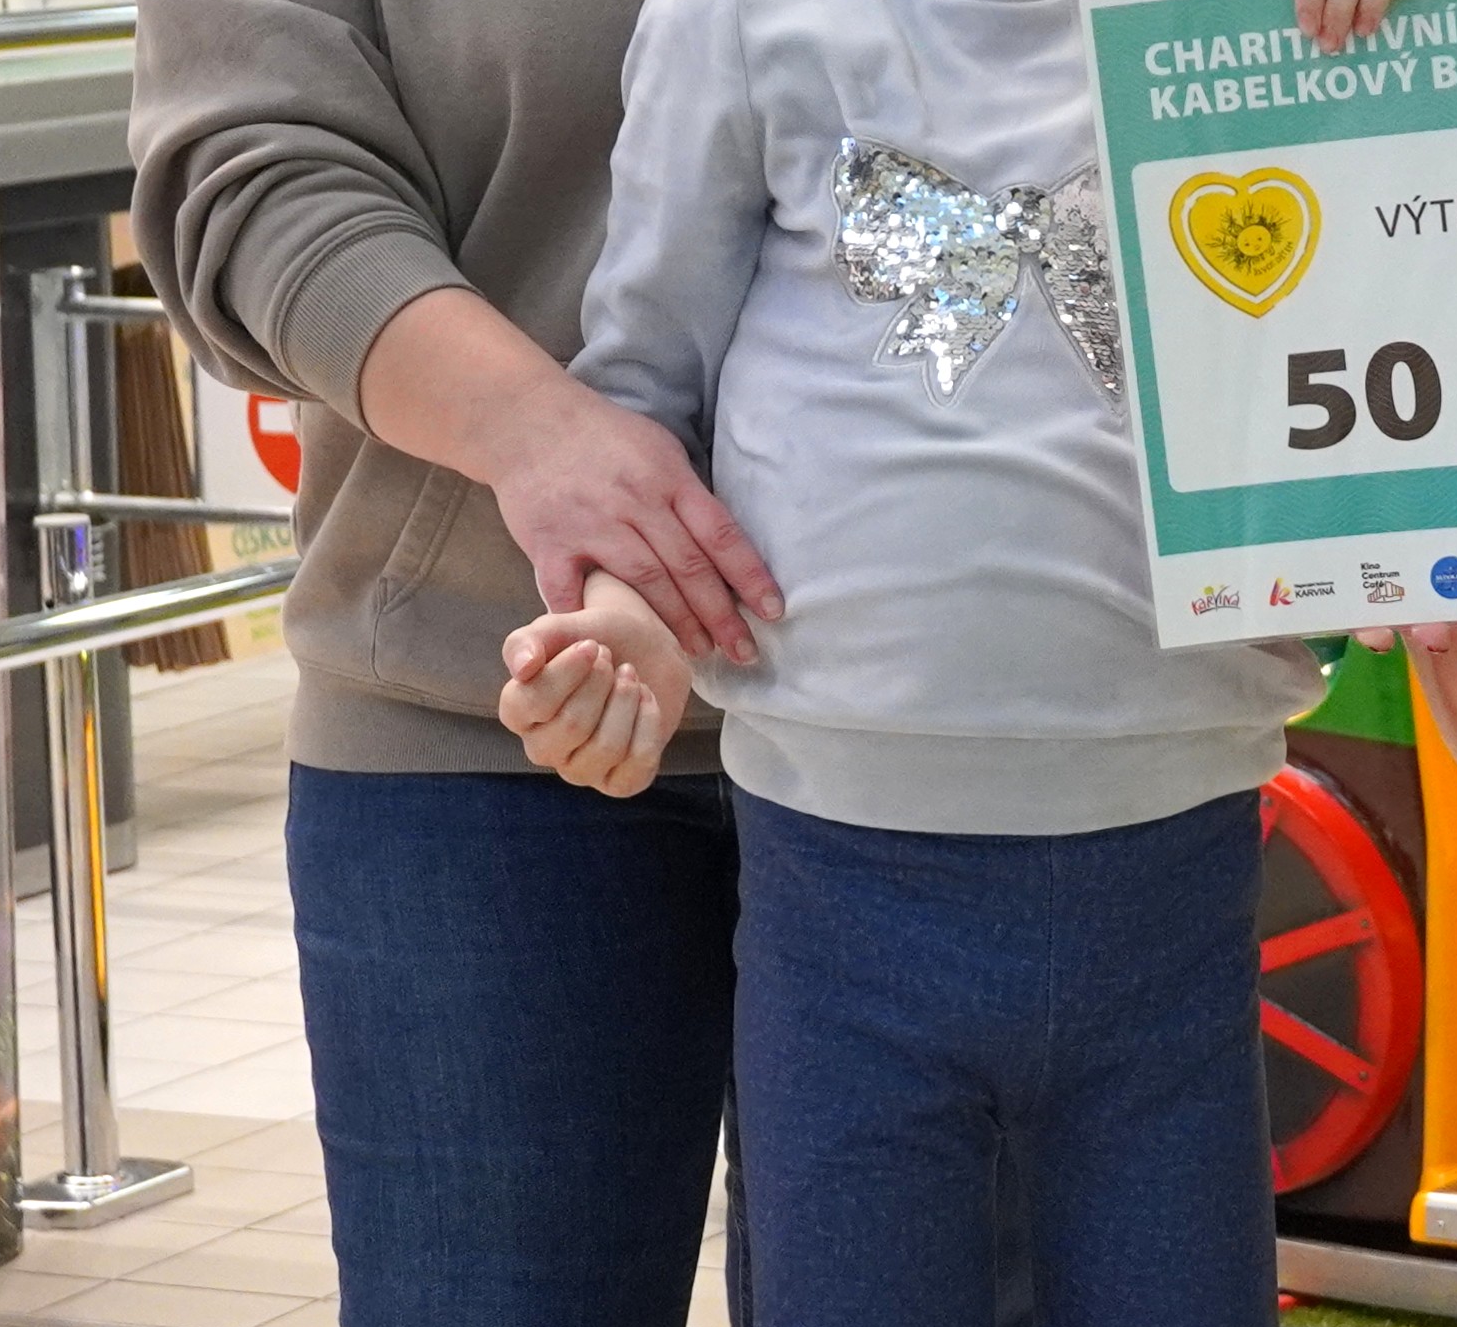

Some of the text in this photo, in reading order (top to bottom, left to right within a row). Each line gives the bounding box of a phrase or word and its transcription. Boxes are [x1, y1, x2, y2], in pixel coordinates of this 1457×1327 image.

[1149, 51, 1418, 121] KABELKOVÝ
[1286, 338, 1443, 450] 50
[1360, 562, 1381, 571] Kino
[1361, 570, 1400, 580] Centrum
[1295, 586, 1335, 598] KARVINÁ
